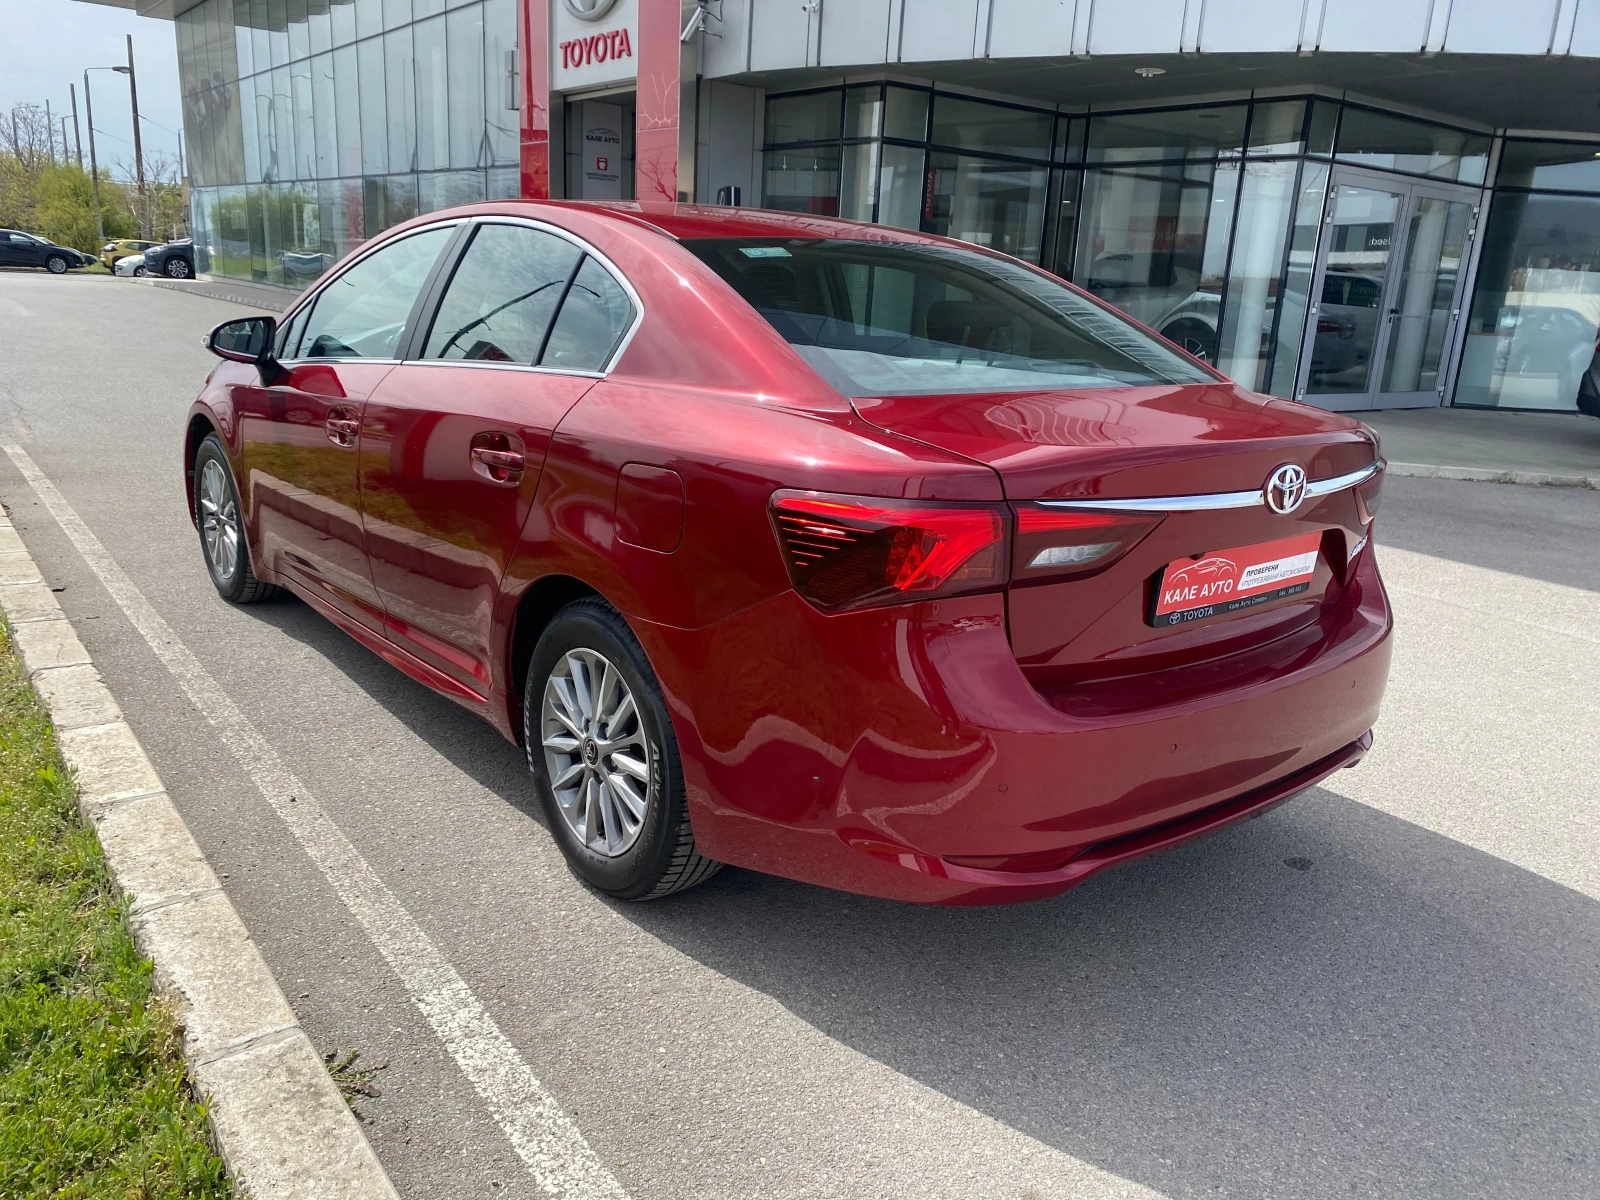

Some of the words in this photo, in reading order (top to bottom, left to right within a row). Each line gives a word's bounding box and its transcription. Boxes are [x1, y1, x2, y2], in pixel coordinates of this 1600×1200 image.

[559, 28, 632, 69] TOYOTA
[1241, 573, 1279, 588] УПОТРЕБЯВАНИ
[1279, 565, 1310, 579] АВТОМОБИЛИ
[1246, 564, 1280, 578] ПРОВЕРЕНИ
[1164, 585, 1198, 605] КАЛЕ
[1200, 579, 1234, 598] АУТО
[1183, 607, 1213, 621] TOYOTA
